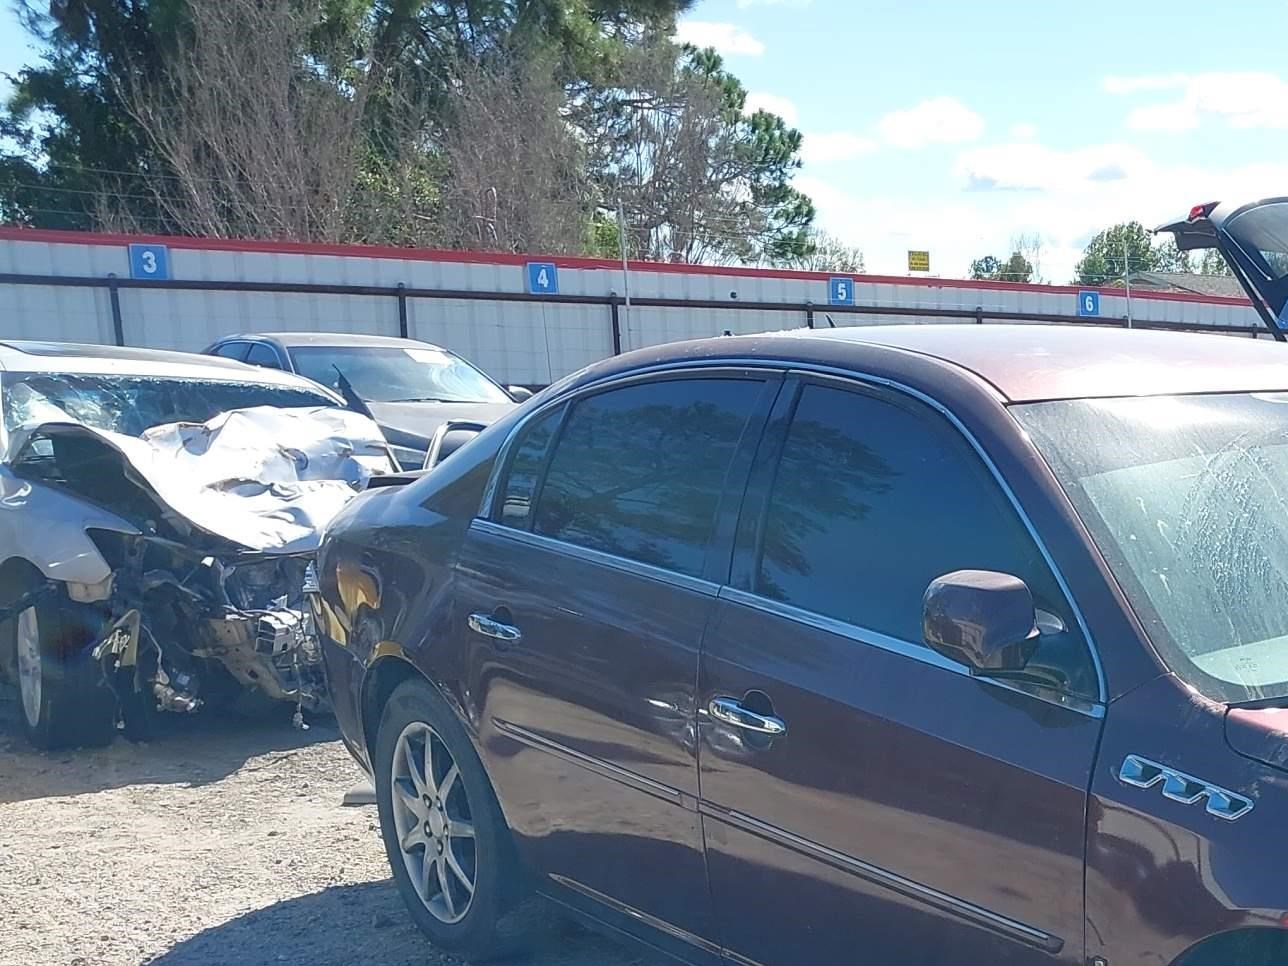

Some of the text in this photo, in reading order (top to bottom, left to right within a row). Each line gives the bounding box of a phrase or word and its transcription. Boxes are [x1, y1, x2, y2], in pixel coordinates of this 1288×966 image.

[142, 251, 156, 274] 3
[538, 269, 549, 288] 4
[838, 283, 847, 300] 5
[1085, 296, 1094, 312] 6
